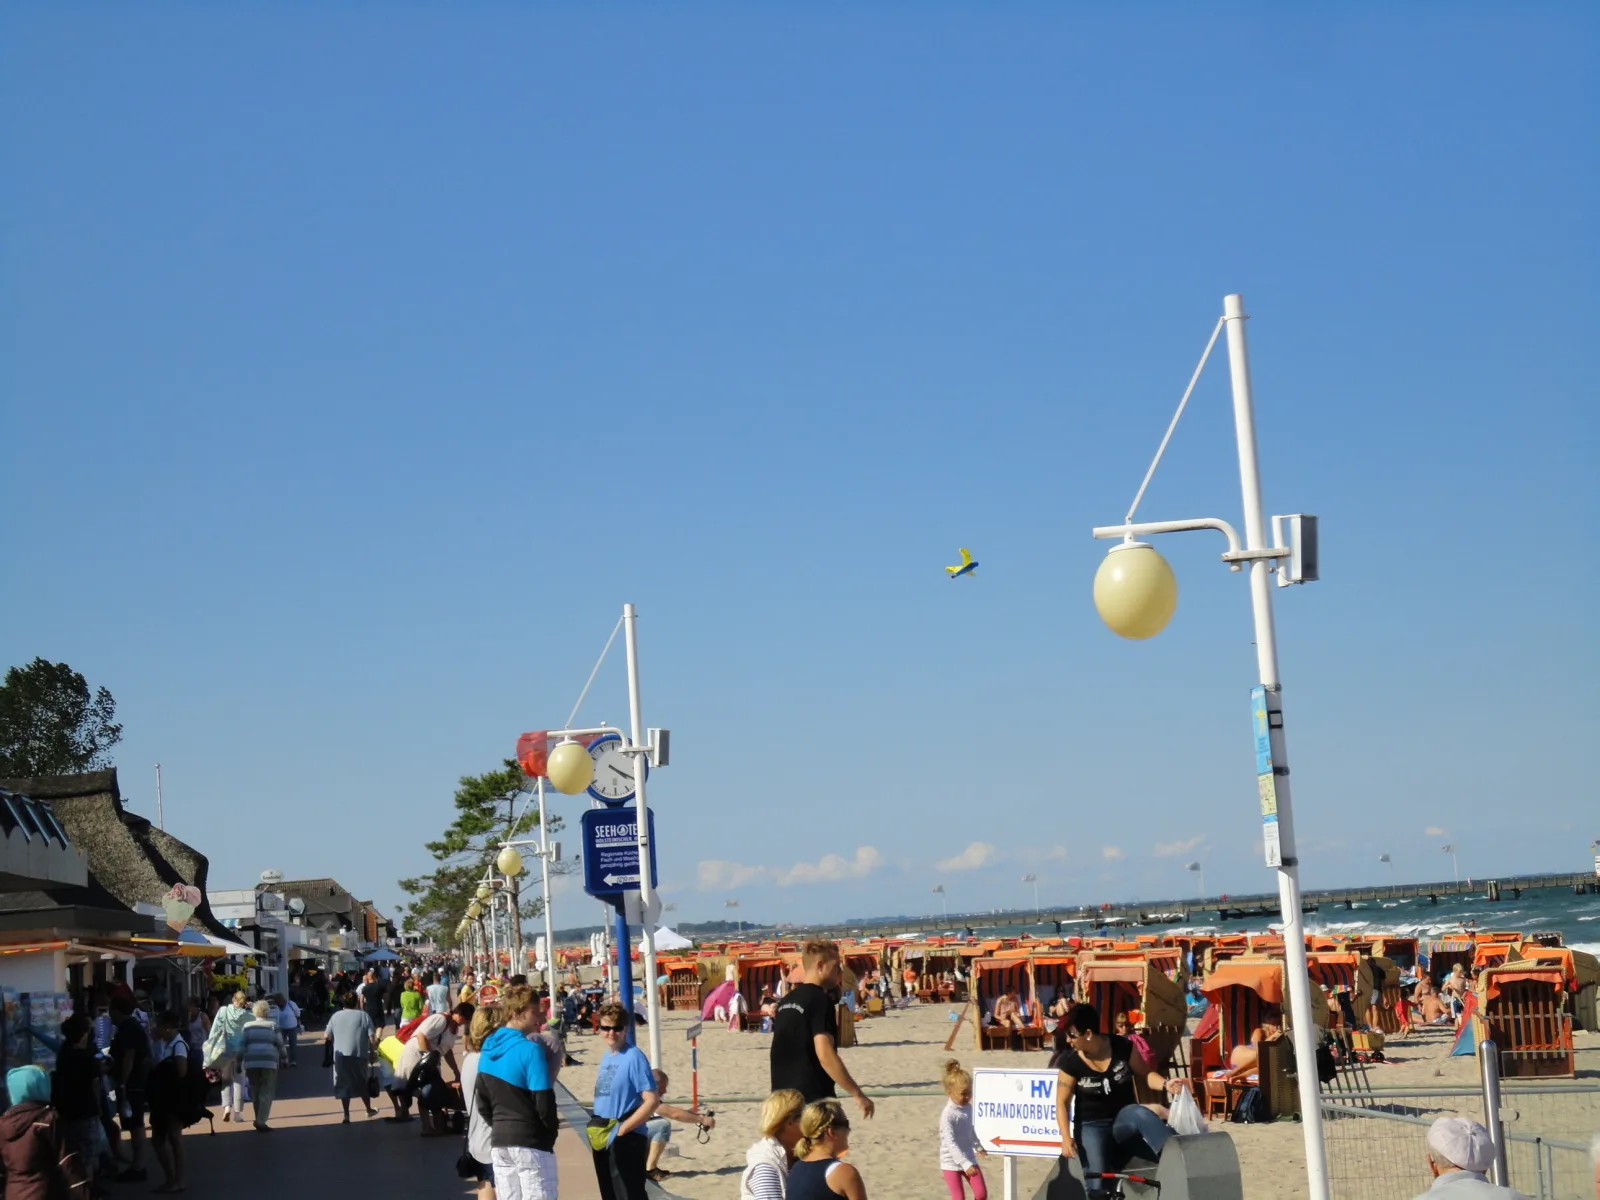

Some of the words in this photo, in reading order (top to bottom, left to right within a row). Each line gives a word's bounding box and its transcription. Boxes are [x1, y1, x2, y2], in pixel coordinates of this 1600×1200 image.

[595, 824, 638, 838] SEEHOTE
[1031, 1080, 1053, 1098] HV
[978, 1102, 1057, 1121] STRANDKORBVE
